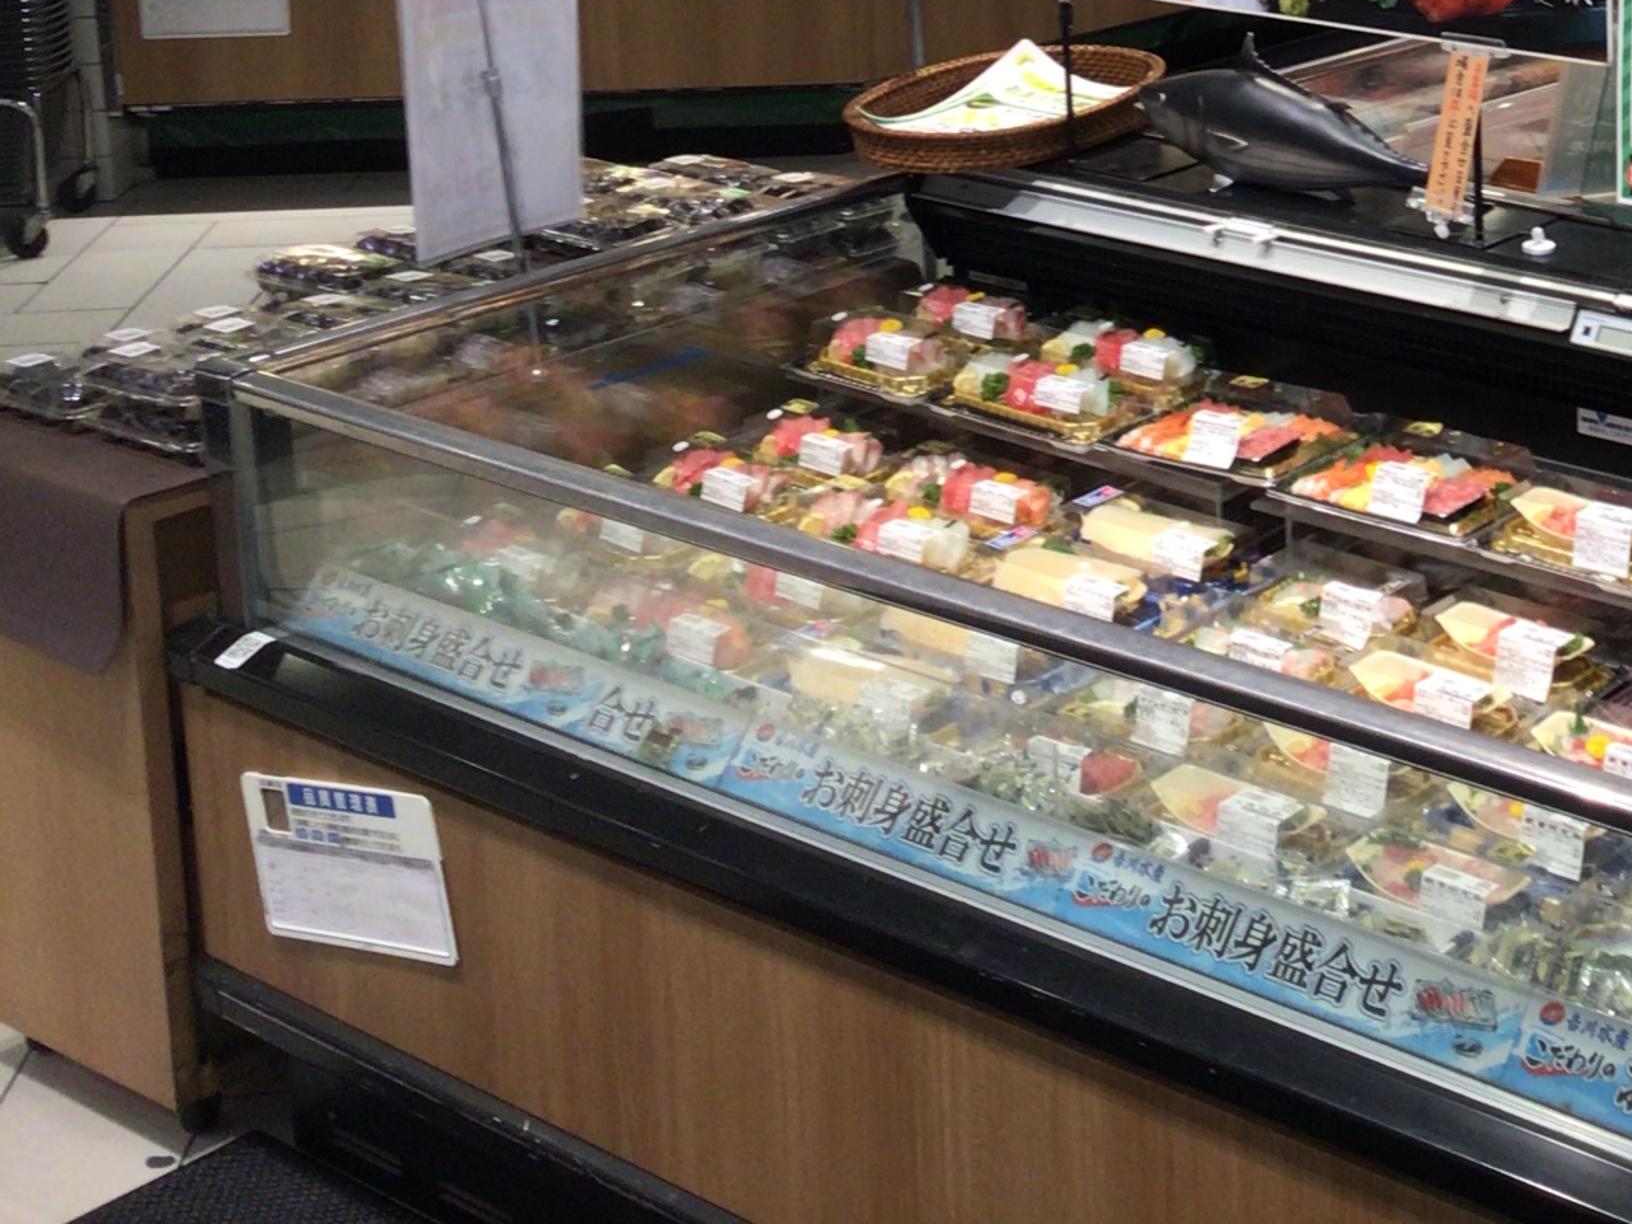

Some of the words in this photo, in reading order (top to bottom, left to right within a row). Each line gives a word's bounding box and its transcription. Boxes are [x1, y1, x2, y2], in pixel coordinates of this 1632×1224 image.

[801, 759, 1019, 875] お刺身盛合せ
[1149, 886, 1403, 1019] お刺身盛合せ
